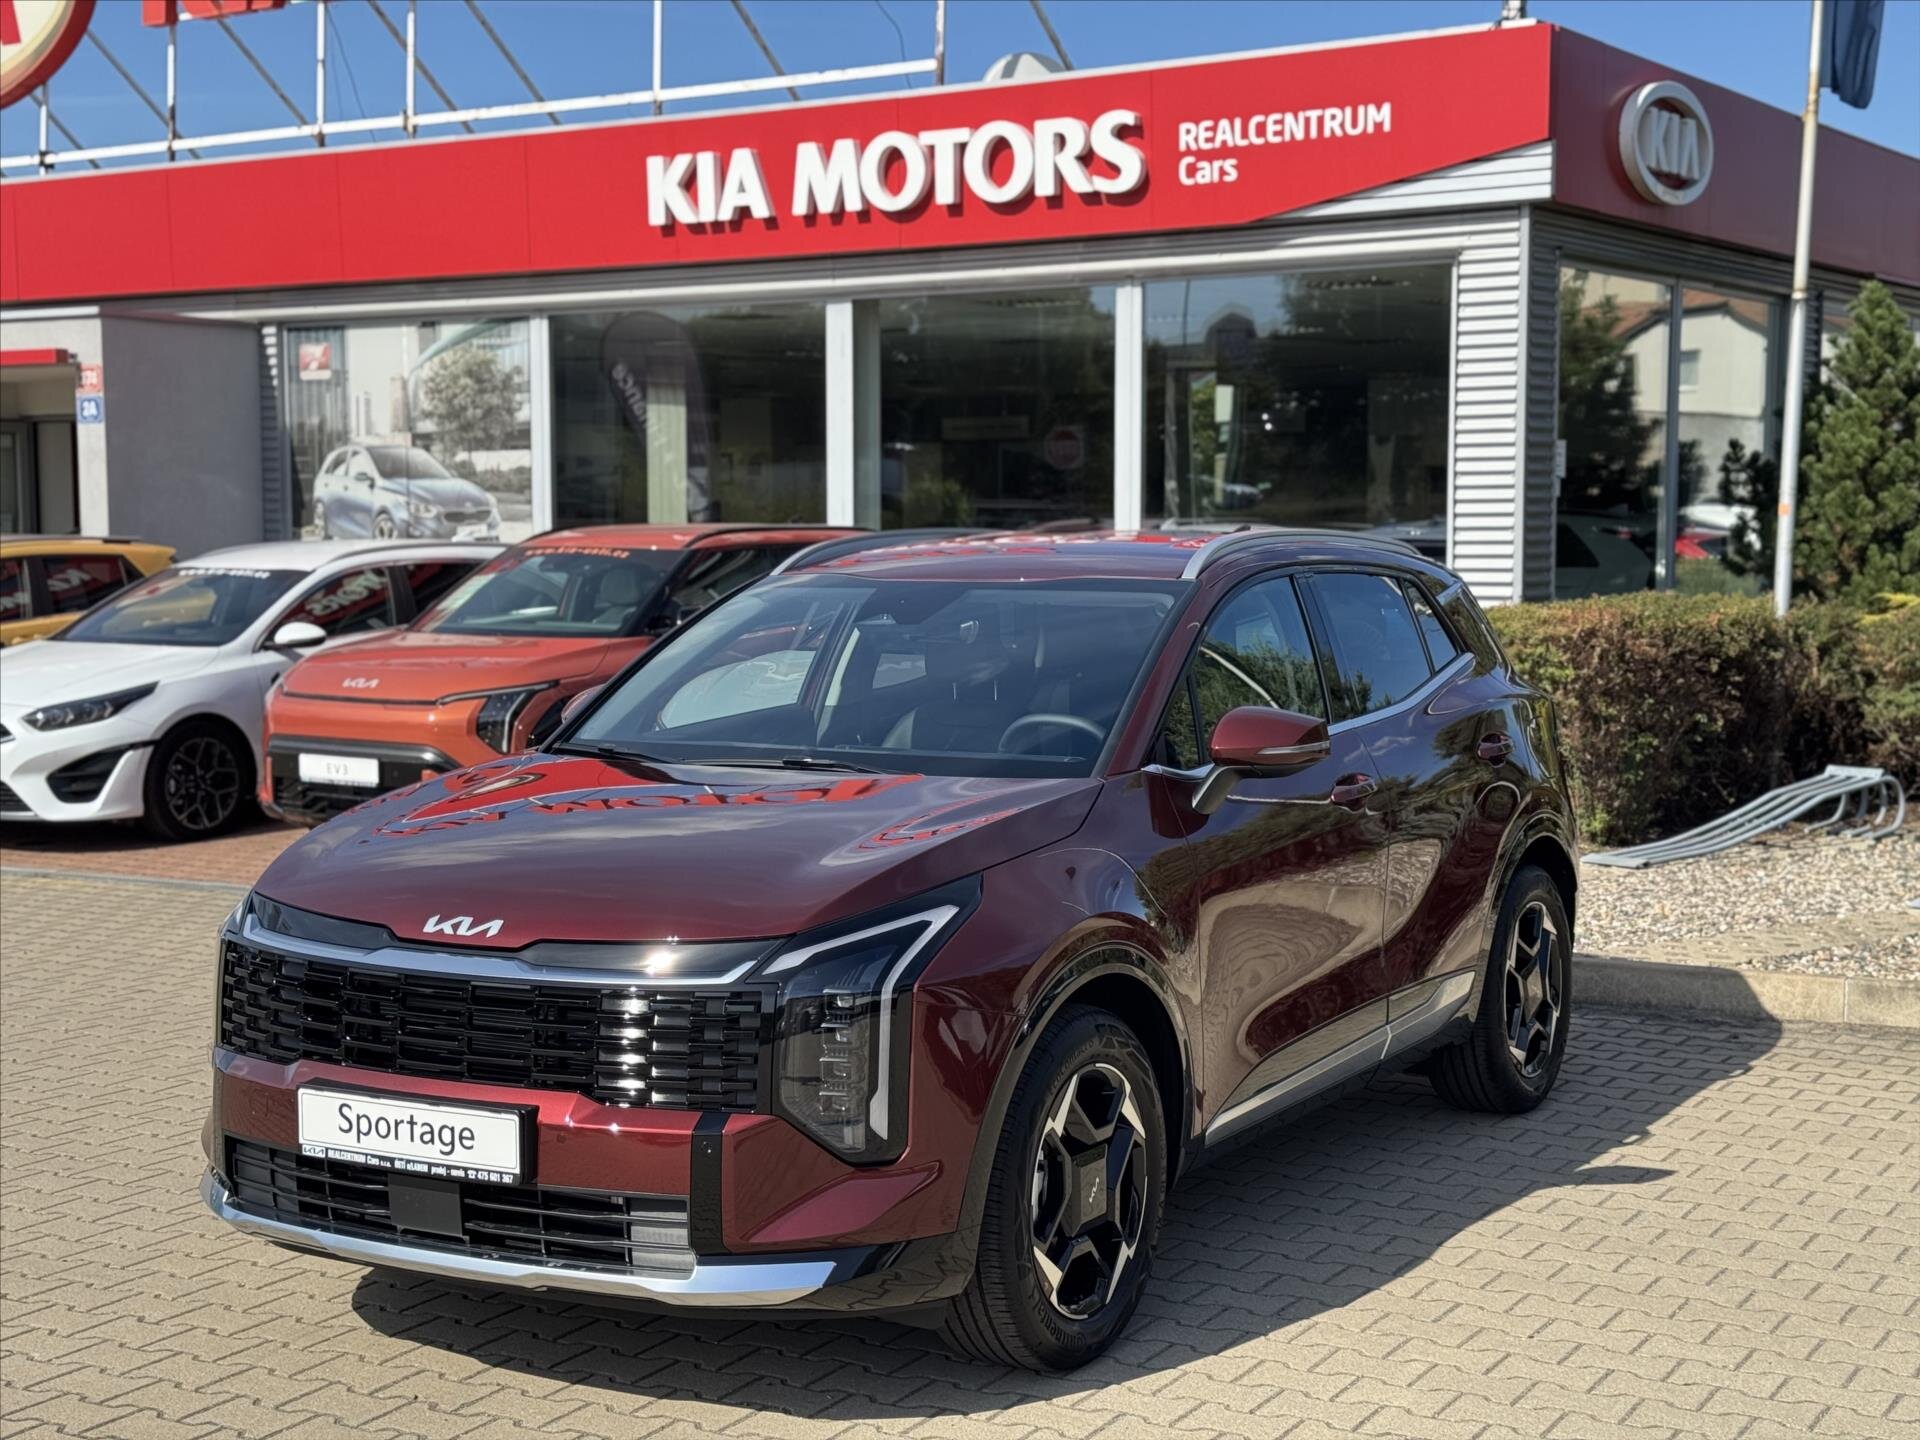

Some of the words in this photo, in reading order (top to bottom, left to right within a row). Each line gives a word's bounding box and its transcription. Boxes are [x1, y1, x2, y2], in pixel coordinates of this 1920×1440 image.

[1178, 101, 1392, 152] REALCENTRUM
[1645, 105, 1700, 180] KIA
[646, 147, 775, 227] KIA
[792, 109, 1146, 216] MOTORS
[1178, 156, 1239, 186] Cars
[326, 762, 349, 776] EV3
[422, 914, 504, 938] KIA
[338, 1102, 475, 1156] Sportage
[303, 1146, 324, 1156] KIA
